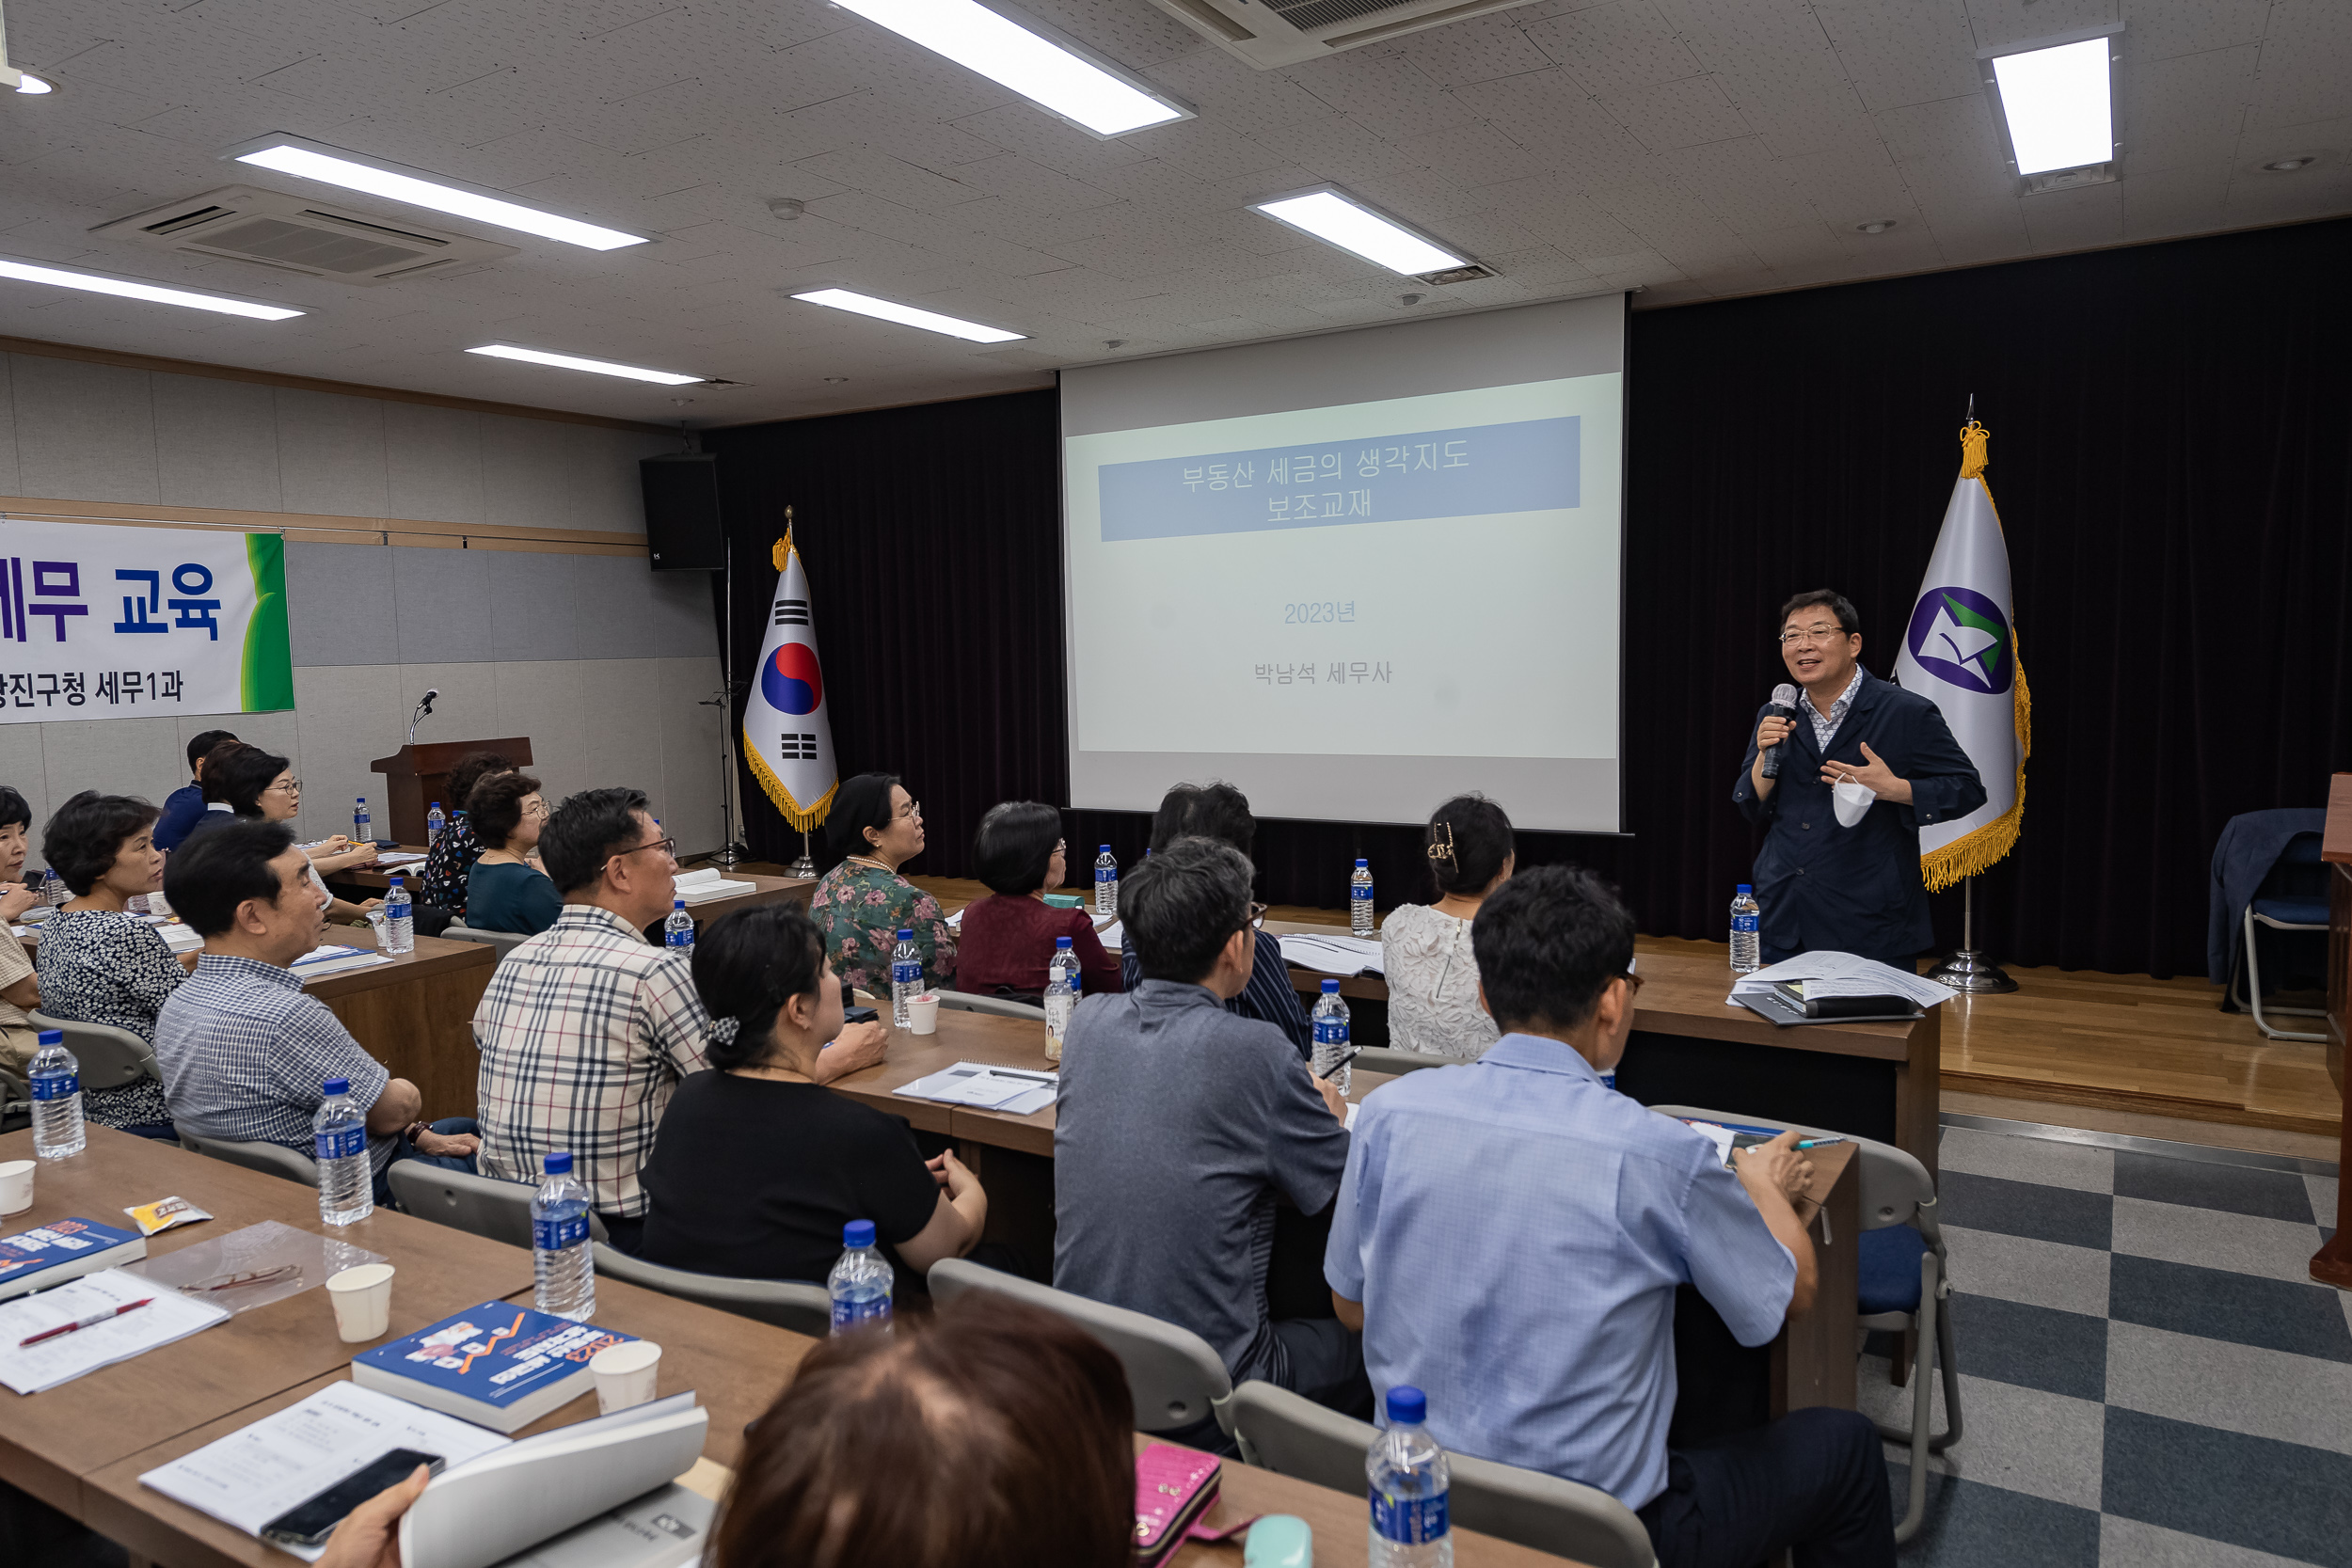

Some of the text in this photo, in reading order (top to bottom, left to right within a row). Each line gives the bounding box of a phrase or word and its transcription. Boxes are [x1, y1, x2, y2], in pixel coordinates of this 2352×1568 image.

[1183, 438, 1470, 494] 부동산 세금의 생각지도
[1267, 487, 1372, 523] 보조교재
[114, 562, 221, 641] 교육
[1284, 599, 1357, 625] 2023년
[94, 670, 184, 705] 세무1과
[1254, 660, 1393, 686] 박남석 세무사
